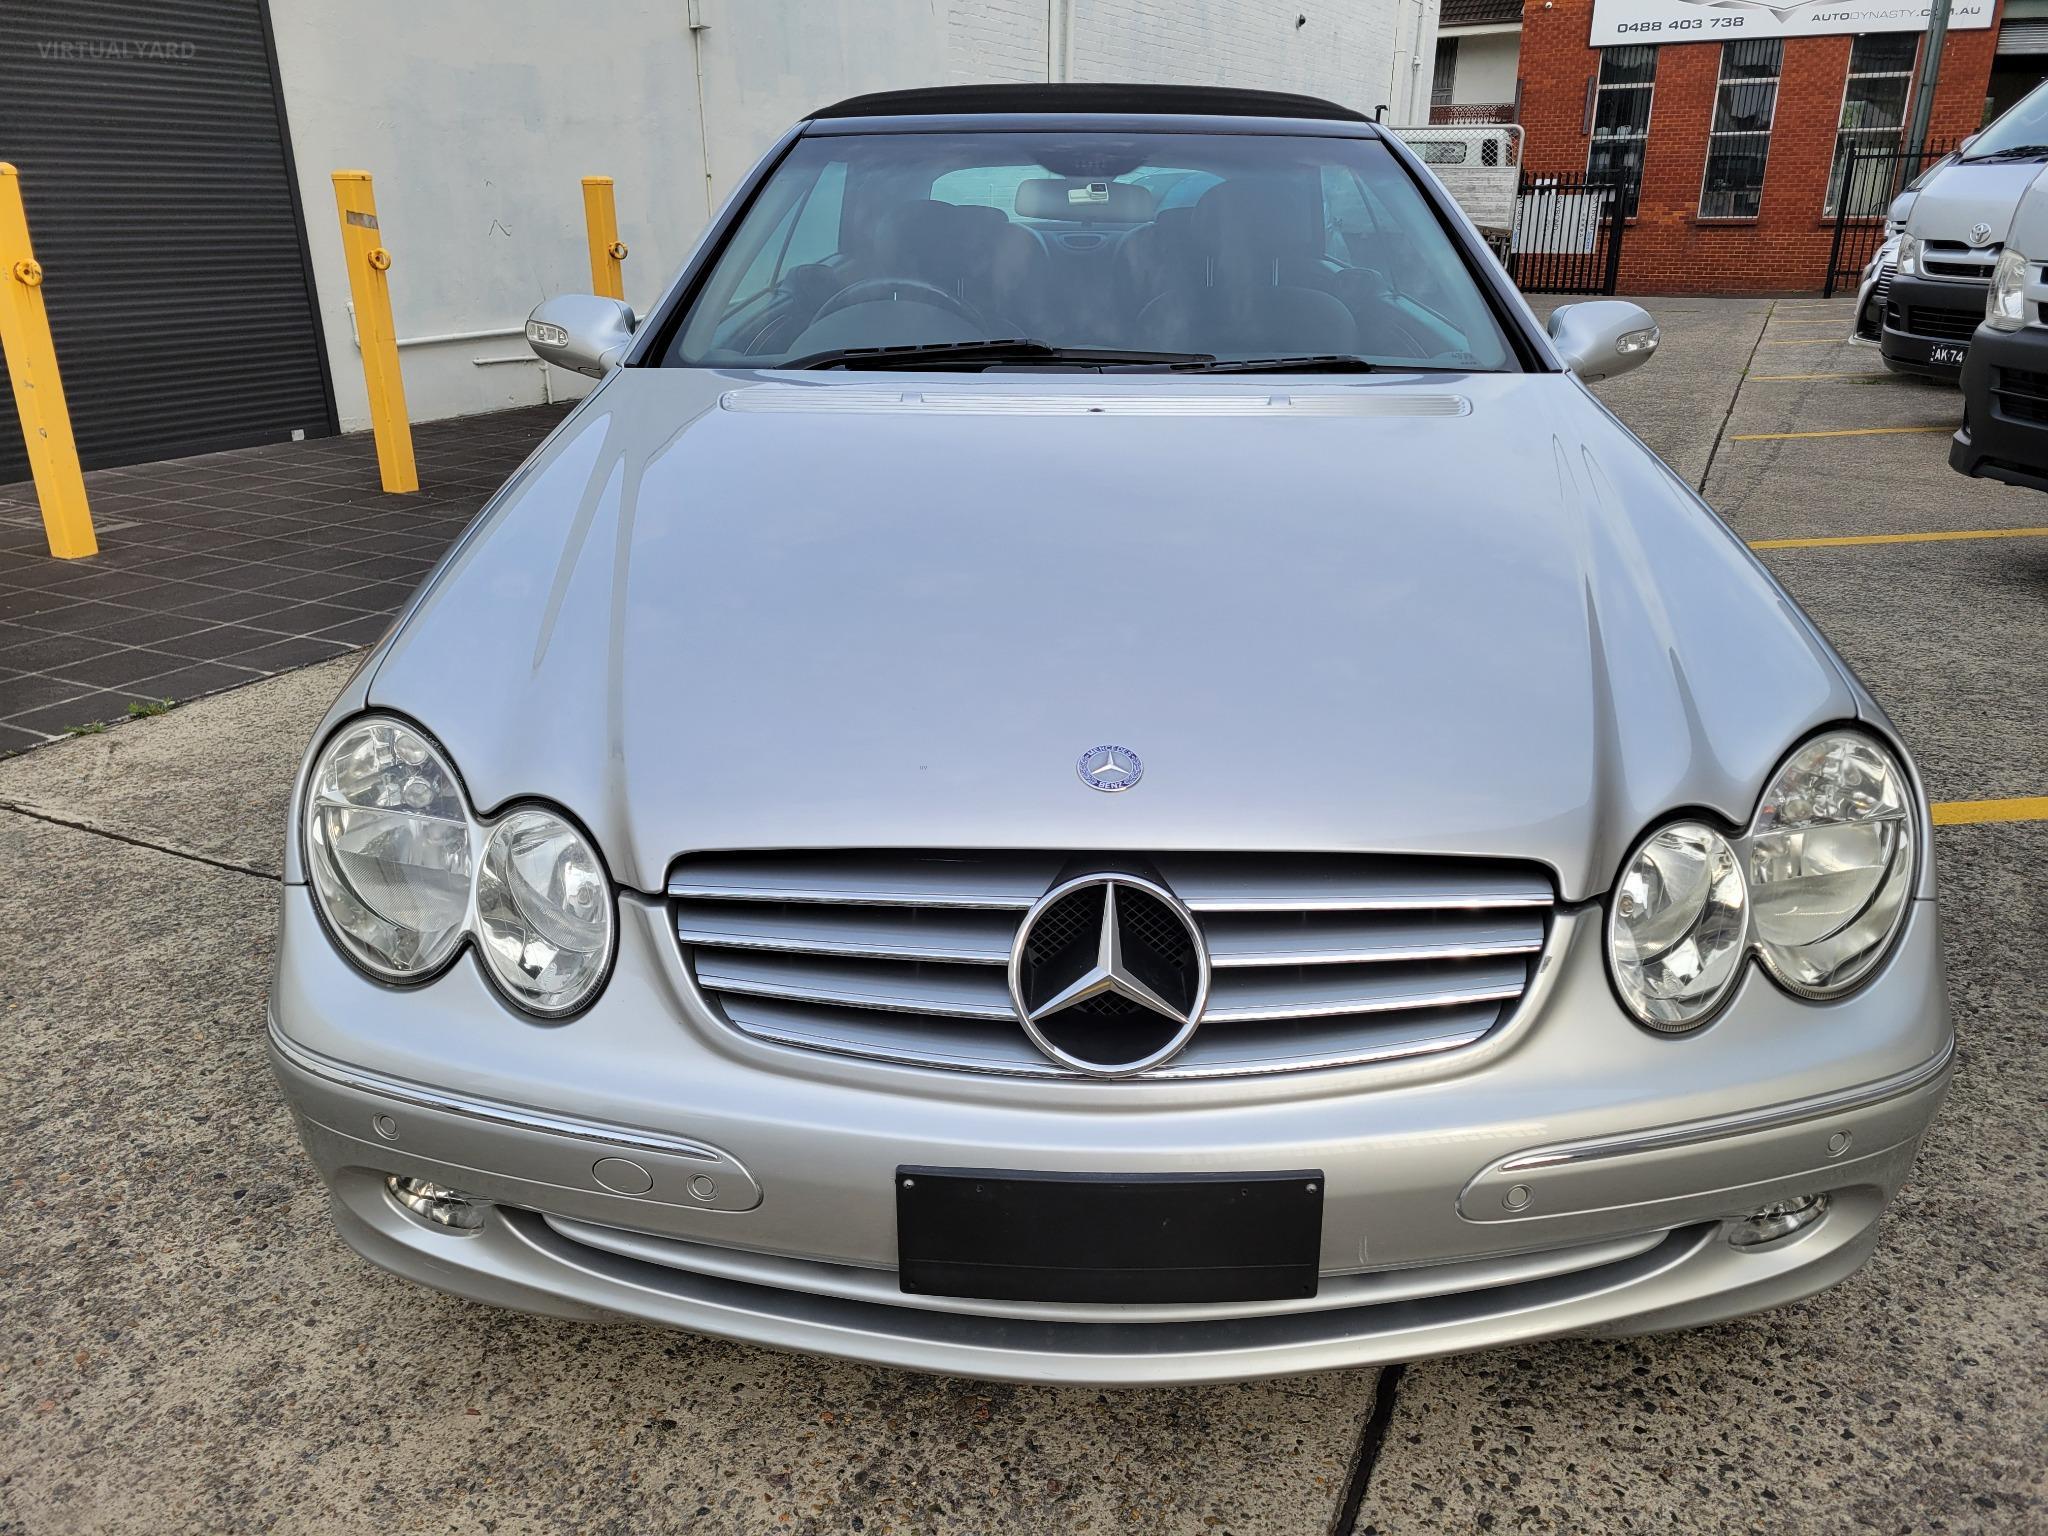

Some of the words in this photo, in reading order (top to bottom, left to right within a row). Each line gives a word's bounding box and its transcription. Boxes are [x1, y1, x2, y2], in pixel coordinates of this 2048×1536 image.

[1617, 21, 1662, 33] 0488
[1668, 19, 1703, 30] 403
[1709, 16, 1745, 28] 738
[1098, 781, 1124, 789] BENZ
